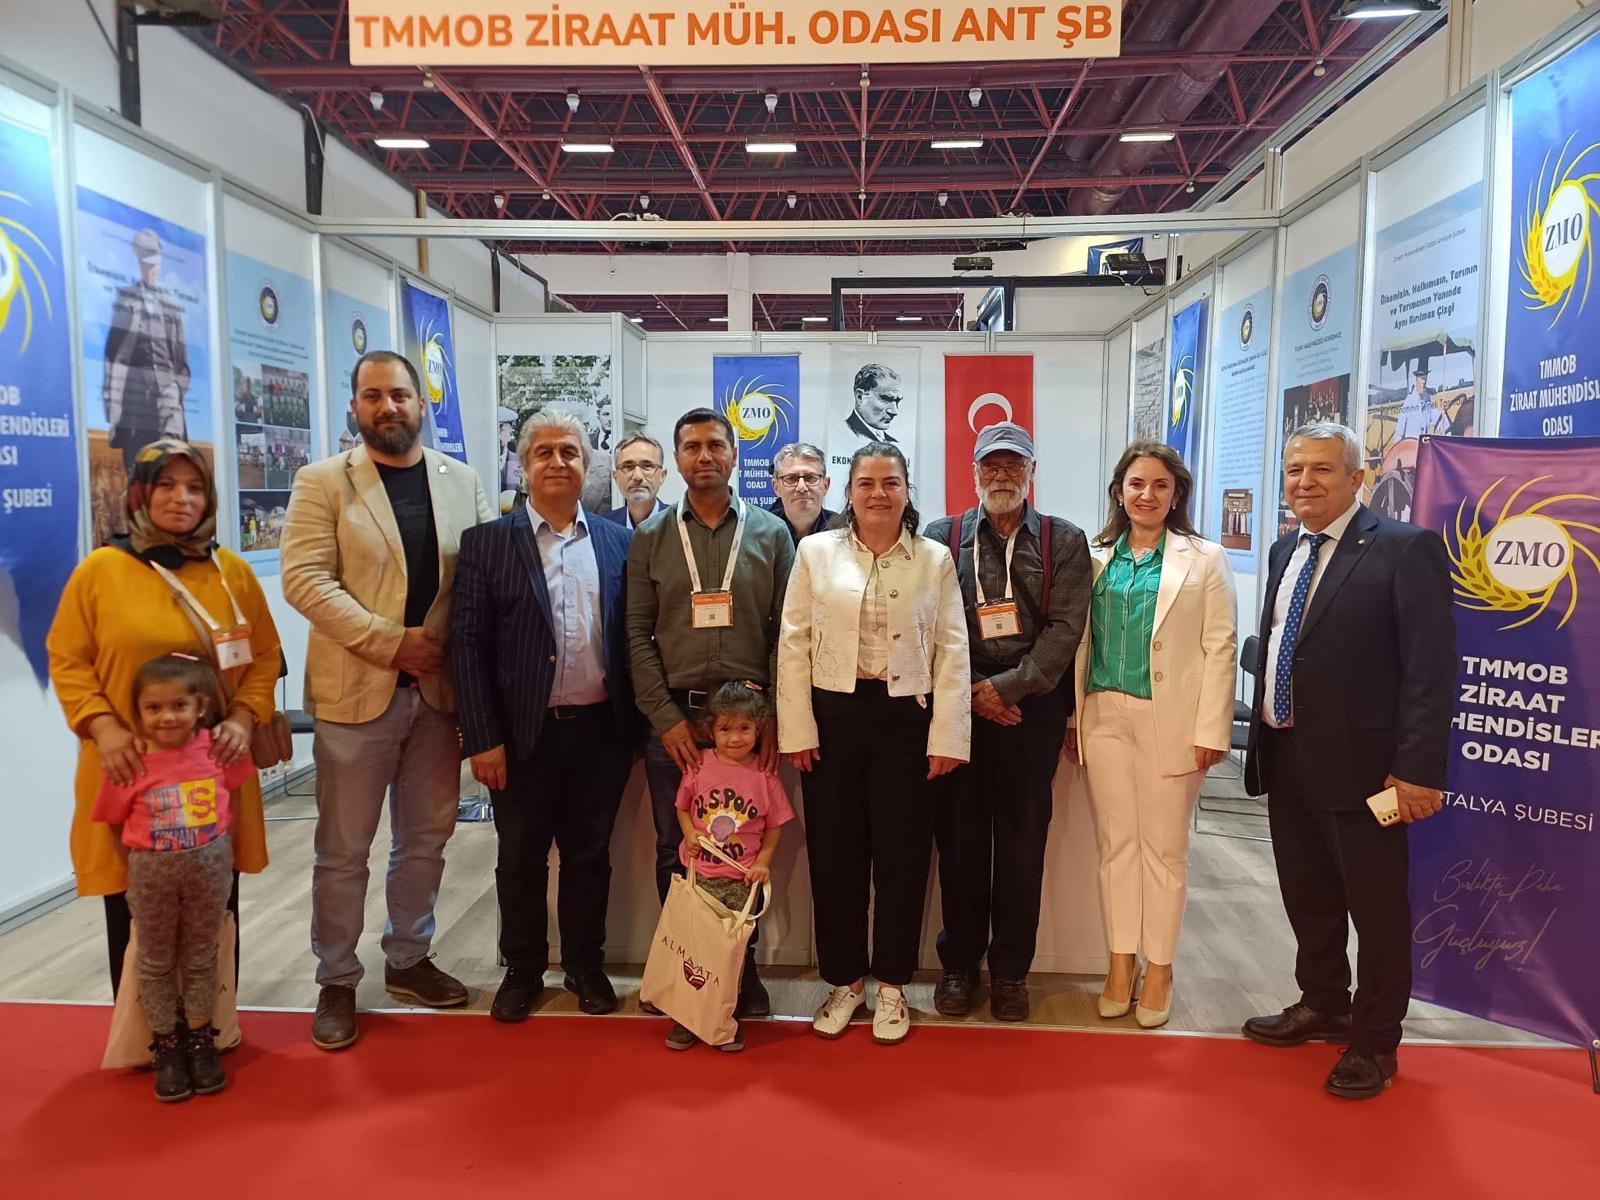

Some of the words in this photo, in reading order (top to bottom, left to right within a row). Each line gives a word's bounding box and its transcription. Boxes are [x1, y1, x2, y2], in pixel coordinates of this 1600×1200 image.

[355, 15, 513, 48] TMMOB
[526, 4, 676, 47] ZİRAAT
[687, 2, 796, 46] MÜH.
[808, 8, 942, 45] ODASI
[952, 6, 1046, 42] ANT
[1056, 5, 1112, 49] ŞB
[1545, 213, 1583, 252] ZMO
[1540, 354, 1577, 379] TMMOB
[1510, 388, 1539, 412] ZİRAAT
[1539, 376, 1600, 408] MÜHENDİSL
[0, 411, 70, 438] ENDİSLERİ
[742, 407, 771, 419] ZMO
[1542, 415, 1574, 437] ODASI
[743, 458, 770, 467] TMMOB
[832, 456, 852, 465] EKON
[2, 483, 53, 514] ŞUBESİ
[746, 481, 767, 489] ODASI
[1494, 540, 1566, 568] ZMO
[1462, 655, 1569, 685] TMMOB
[1459, 682, 1566, 714] ZİRAAT
[1451, 712, 1600, 749] HENDİSLER
[1461, 741, 1551, 772] ODASI
[1442, 791, 1507, 816] TALYA
[1513, 803, 1595, 832] ŞUBESİ
